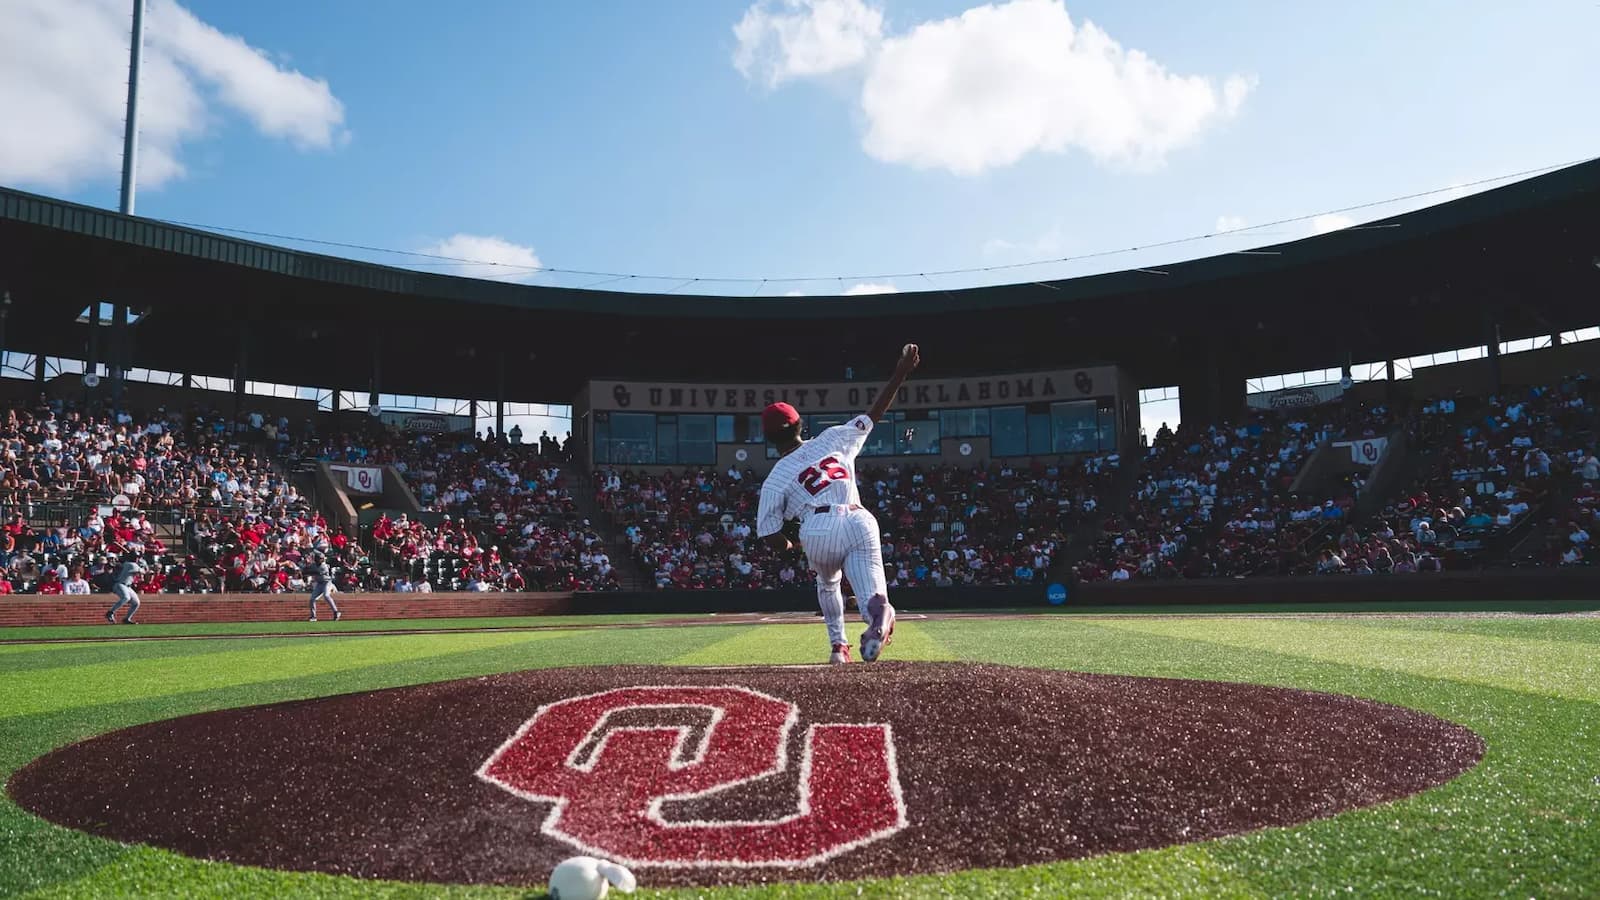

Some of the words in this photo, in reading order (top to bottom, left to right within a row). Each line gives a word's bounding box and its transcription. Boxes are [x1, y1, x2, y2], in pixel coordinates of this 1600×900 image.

[648, 387, 830, 408] UNIVERSITY
[847, 386, 878, 406] OF
[897, 376, 1057, 405] OKLAHOMA
[1362, 442, 1378, 462] OU
[358, 470, 372, 489] OU
[797, 454, 850, 497] 26
[475, 684, 909, 869] OU
